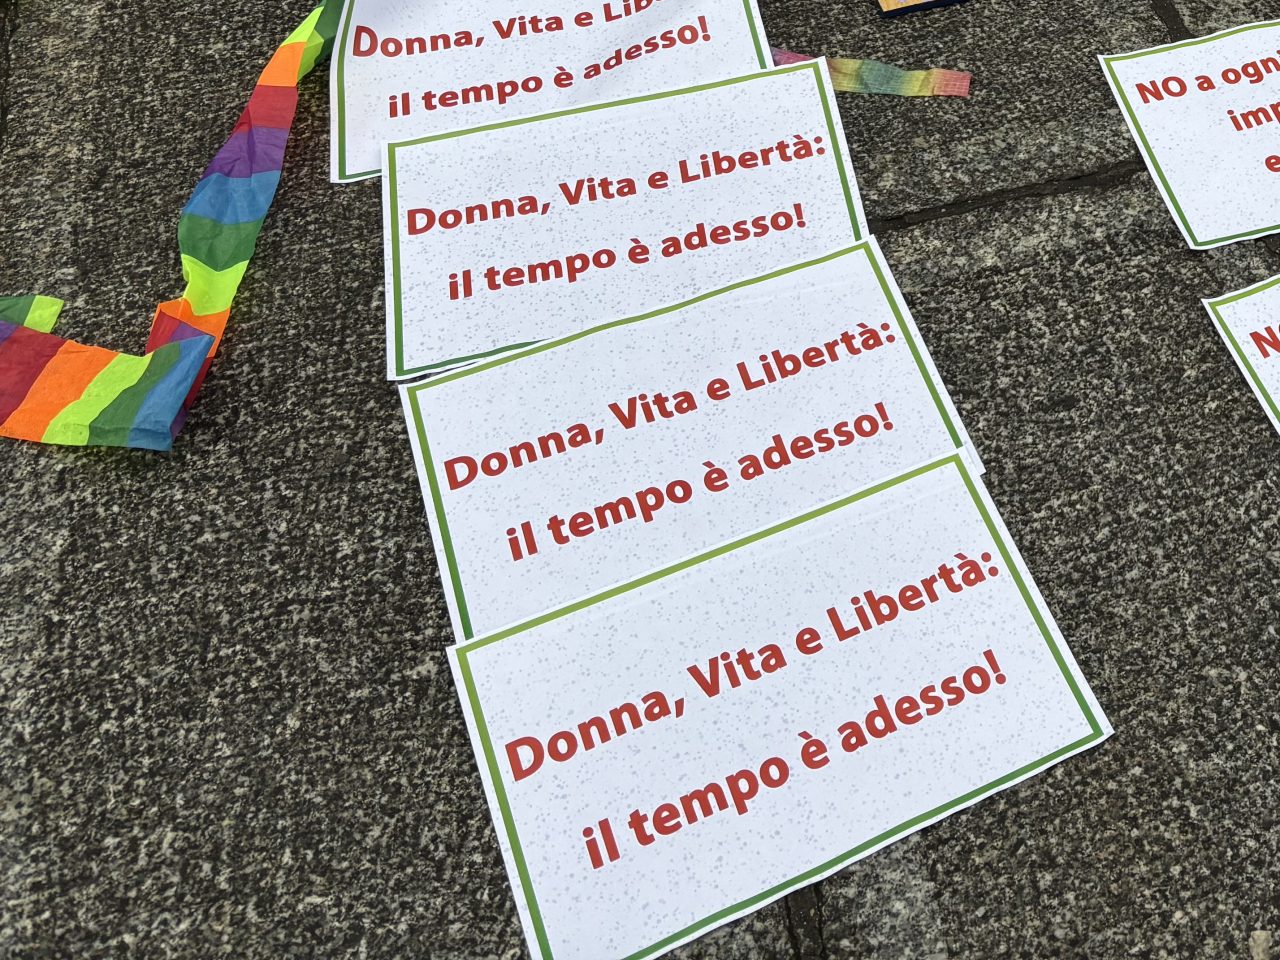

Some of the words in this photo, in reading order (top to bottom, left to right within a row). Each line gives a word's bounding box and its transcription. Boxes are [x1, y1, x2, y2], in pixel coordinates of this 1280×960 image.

[352, 25, 485, 58] Donna,
[492, 15, 564, 40] Vita
[574, 11, 594, 28] e
[388, 91, 411, 119] il
[421, 75, 544, 112] tempo
[553, 66, 575, 89] è
[583, 15, 712, 80] adesso!
[1135, 75, 1188, 105] NO
[1195, 74, 1217, 92] a
[406, 195, 551, 237] Donna,
[559, 177, 637, 206] Vita
[647, 171, 670, 190] e
[678, 134, 826, 184] Libertà:
[448, 269, 473, 301] il
[484, 248, 617, 292] tempo
[627, 238, 650, 265] è
[661, 202, 807, 258] adesso!
[443, 422, 604, 491] Donna,
[608, 391, 698, 430] Vita
[705, 377, 732, 402] e
[736, 322, 896, 391] Libertà:
[506, 521, 538, 561] il
[546, 479, 693, 546] tempo
[703, 460, 730, 493] è
[738, 402, 894, 481] adesso!
[504, 690, 685, 782] Donna,
[687, 643, 788, 698] Vita
[795, 626, 824, 656] e
[826, 551, 999, 642] Libertà:
[582, 818, 621, 870] il
[627, 756, 790, 847] tempo
[799, 731, 830, 770] è
[837, 649, 1007, 753] adesso!
